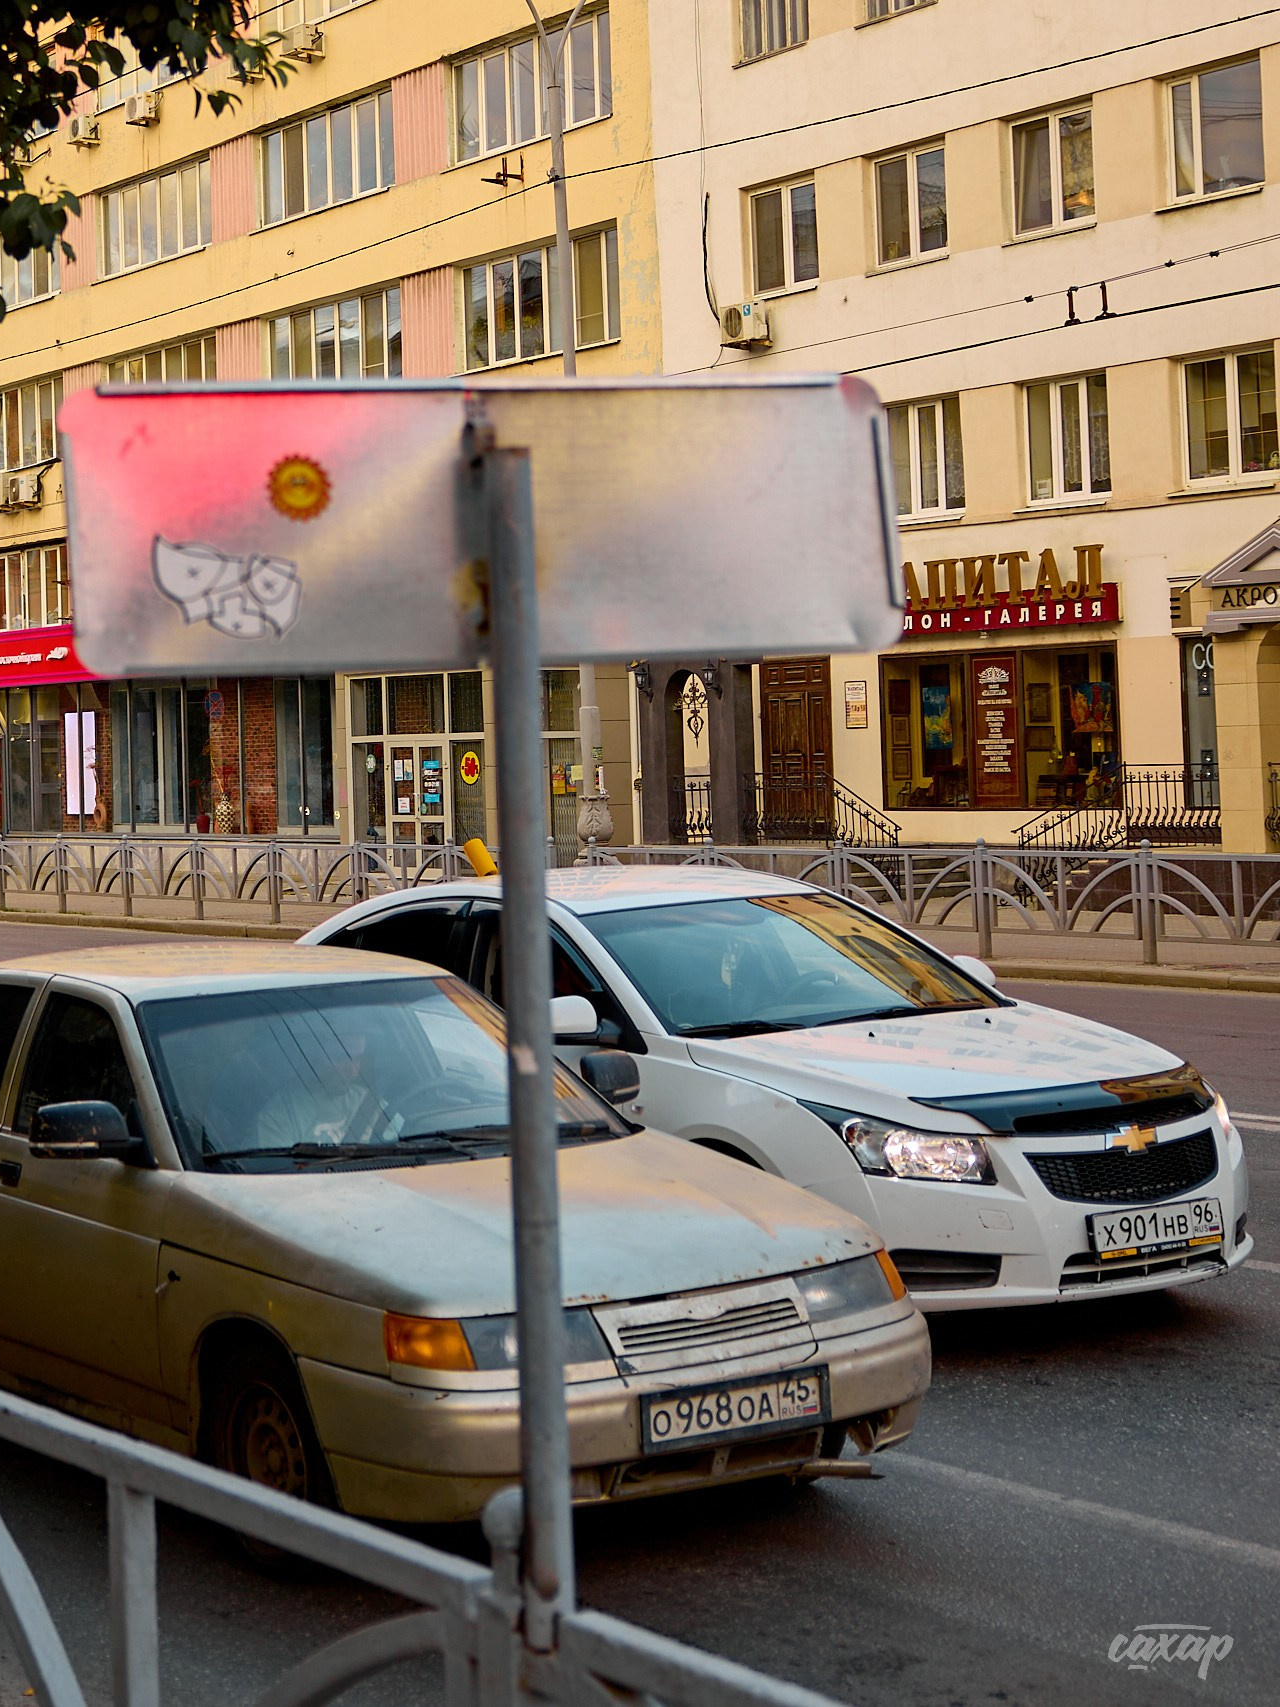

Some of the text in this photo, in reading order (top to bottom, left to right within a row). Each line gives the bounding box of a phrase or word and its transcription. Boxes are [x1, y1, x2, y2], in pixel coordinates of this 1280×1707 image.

[984, 601, 1102, 625] ГАЛЕРЕЯ
[1103, 1203, 1213, 1247] Х901НВ 96
[1194, 1225, 1209, 1233] RUS
[653, 1378, 810, 1437] О968ОА 45
[782, 1406, 802, 1416] RUS
